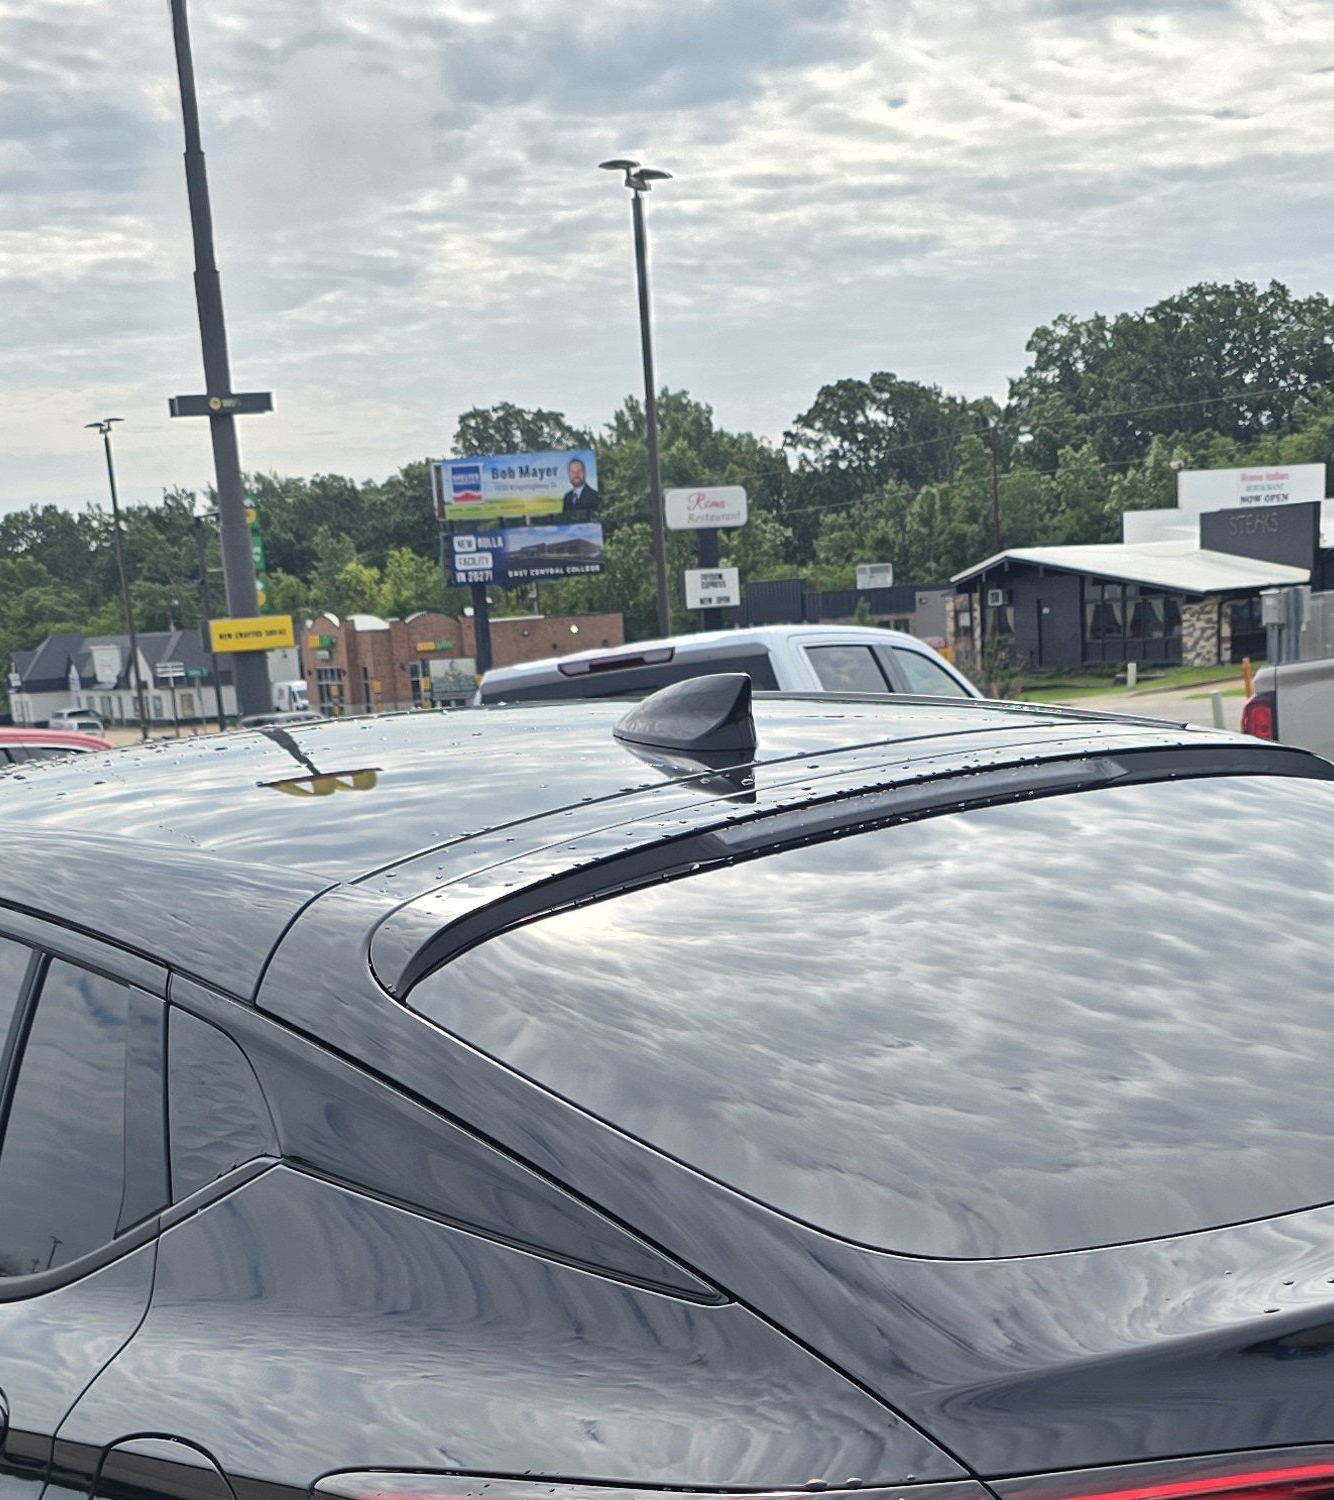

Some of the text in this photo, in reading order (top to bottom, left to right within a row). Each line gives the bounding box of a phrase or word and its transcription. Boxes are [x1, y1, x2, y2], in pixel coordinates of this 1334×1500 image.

[491, 465, 558, 480] Bob Mayer
[1241, 493, 1289, 504] NOW OPEN
[1229, 512, 1279, 536] STEAKS
[458, 556, 489, 566] FACILITY
[566, 565, 601, 574] COLLEGE
